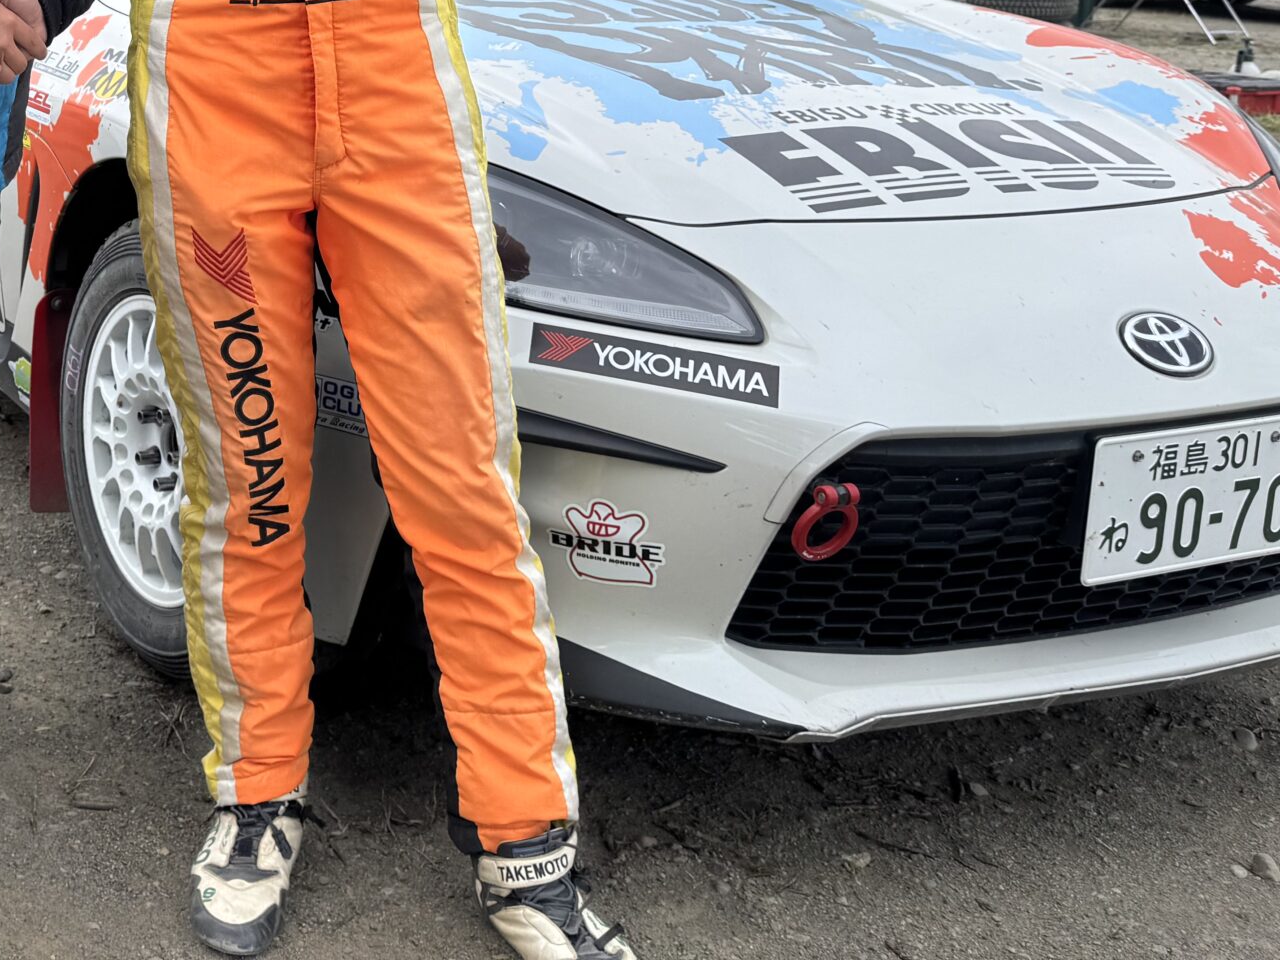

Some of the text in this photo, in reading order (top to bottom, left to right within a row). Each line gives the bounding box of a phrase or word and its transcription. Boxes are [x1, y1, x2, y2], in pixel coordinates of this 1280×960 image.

[771, 102, 1026, 125] EBISU CIRCUIT
[592, 341, 770, 397] YOKOHAMA
[322, 395, 361, 418] CLU
[213, 307, 291, 548] YOKOHAMA
[1148, 430, 1262, 481] 福島 301
[550, 529, 663, 563] BRIDE
[1098, 517, 1129, 554] ね
[576, 551, 640, 568] HOLDING MONSTER
[497, 853, 569, 883] TAKEMOTO
